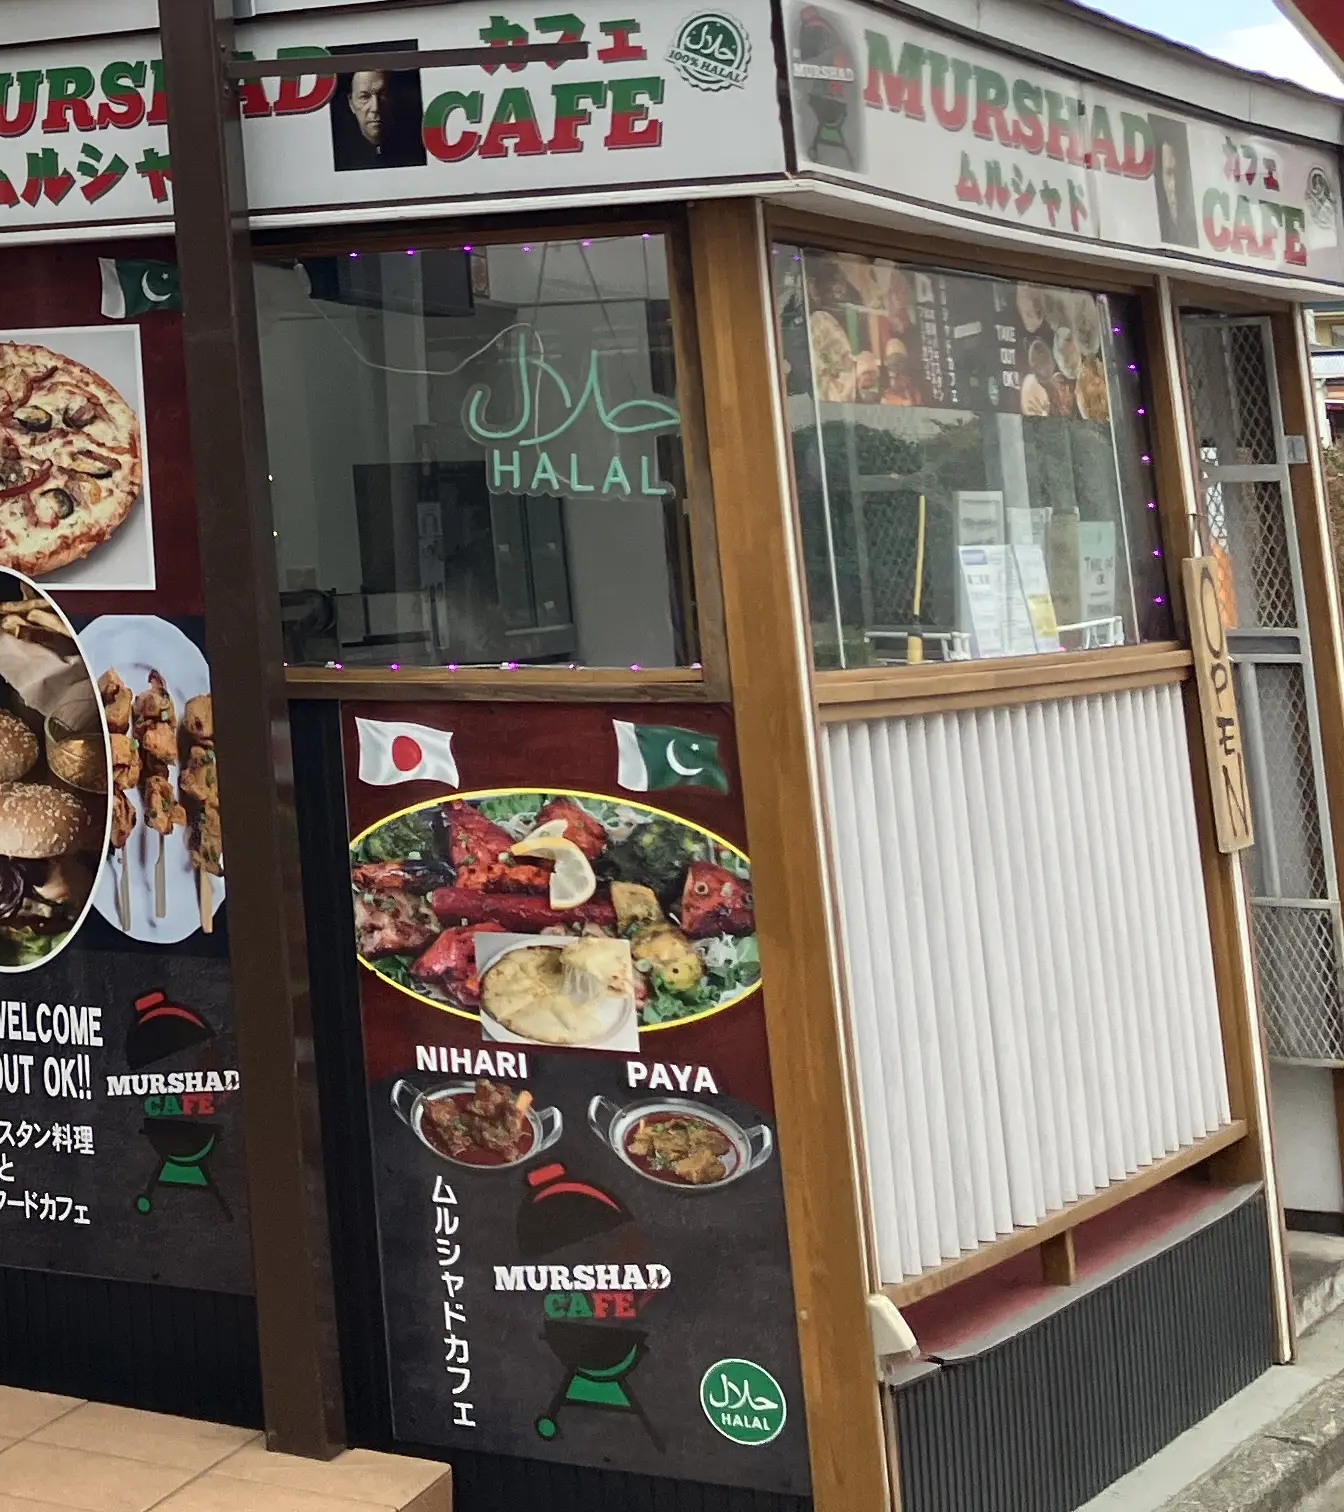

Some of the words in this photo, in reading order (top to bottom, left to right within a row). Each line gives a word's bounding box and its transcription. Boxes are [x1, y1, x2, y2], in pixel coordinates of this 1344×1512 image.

[480, 13, 648, 75] カフェ
[668, 48, 699, 68] 100%
[699, 60, 741, 83] HALAL
[422, 76, 665, 163] CAFE
[863, 28, 1156, 180] MURSHAD
[1202, 186, 1308, 267] CAFE
[493, 449, 667, 496] HALAL
[1200, 567, 1250, 839] OPEN
[43, 1053, 93, 1100] OK!!
[415, 1044, 528, 1079] NIHARI
[627, 1060, 719, 1095] PAYA
[106, 1069, 241, 1097] MURSHAD
[143, 1094, 217, 1117] CAFE
[493, 1263, 672, 1291] MURSHAD
[431, 1174, 477, 1429] ムルシャドカフェ
[543, 1290, 637, 1320] CAFE
[709, 1373, 780, 1412] حلال
[720, 1412, 772, 1432] HALAL
